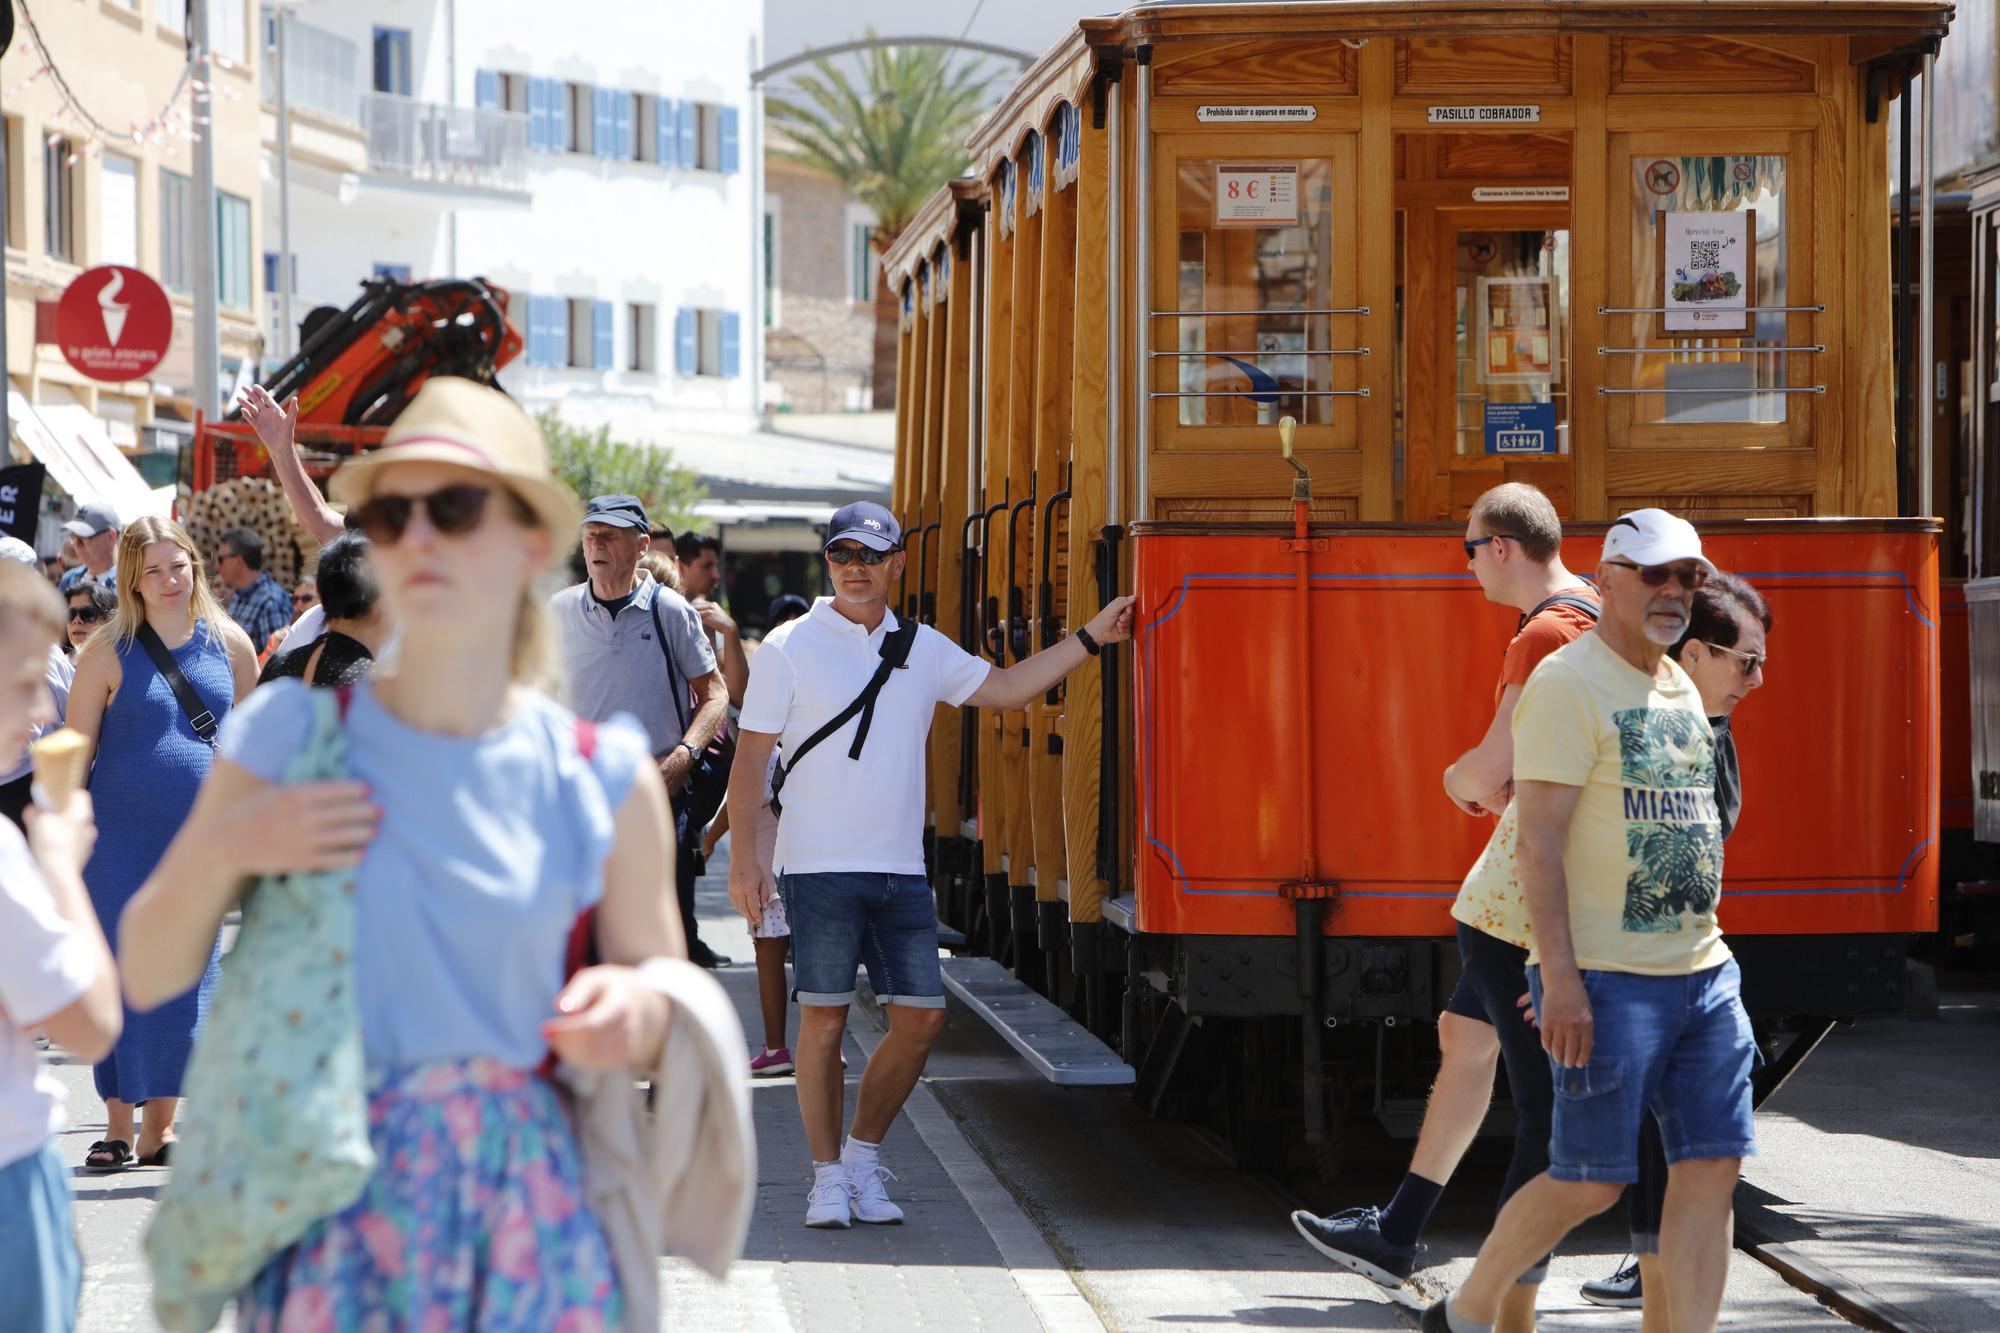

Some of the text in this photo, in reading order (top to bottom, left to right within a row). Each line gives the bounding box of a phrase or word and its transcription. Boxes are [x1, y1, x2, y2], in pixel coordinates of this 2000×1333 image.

[1206, 107, 1234, 117] Prohibido
[1234, 107, 1249, 117] subir
[1254, 108, 1278, 118] apearse
[1278, 108, 1287, 117] en
[1287, 107, 1308, 117] marcha
[1436, 108, 1531, 120] PASILLO COBRADOR
[1228, 180, 1240, 199] 8
[1247, 180, 1259, 199] €
[0, 485, 18, 538] ER
[1624, 788, 1700, 820] MIAMI
